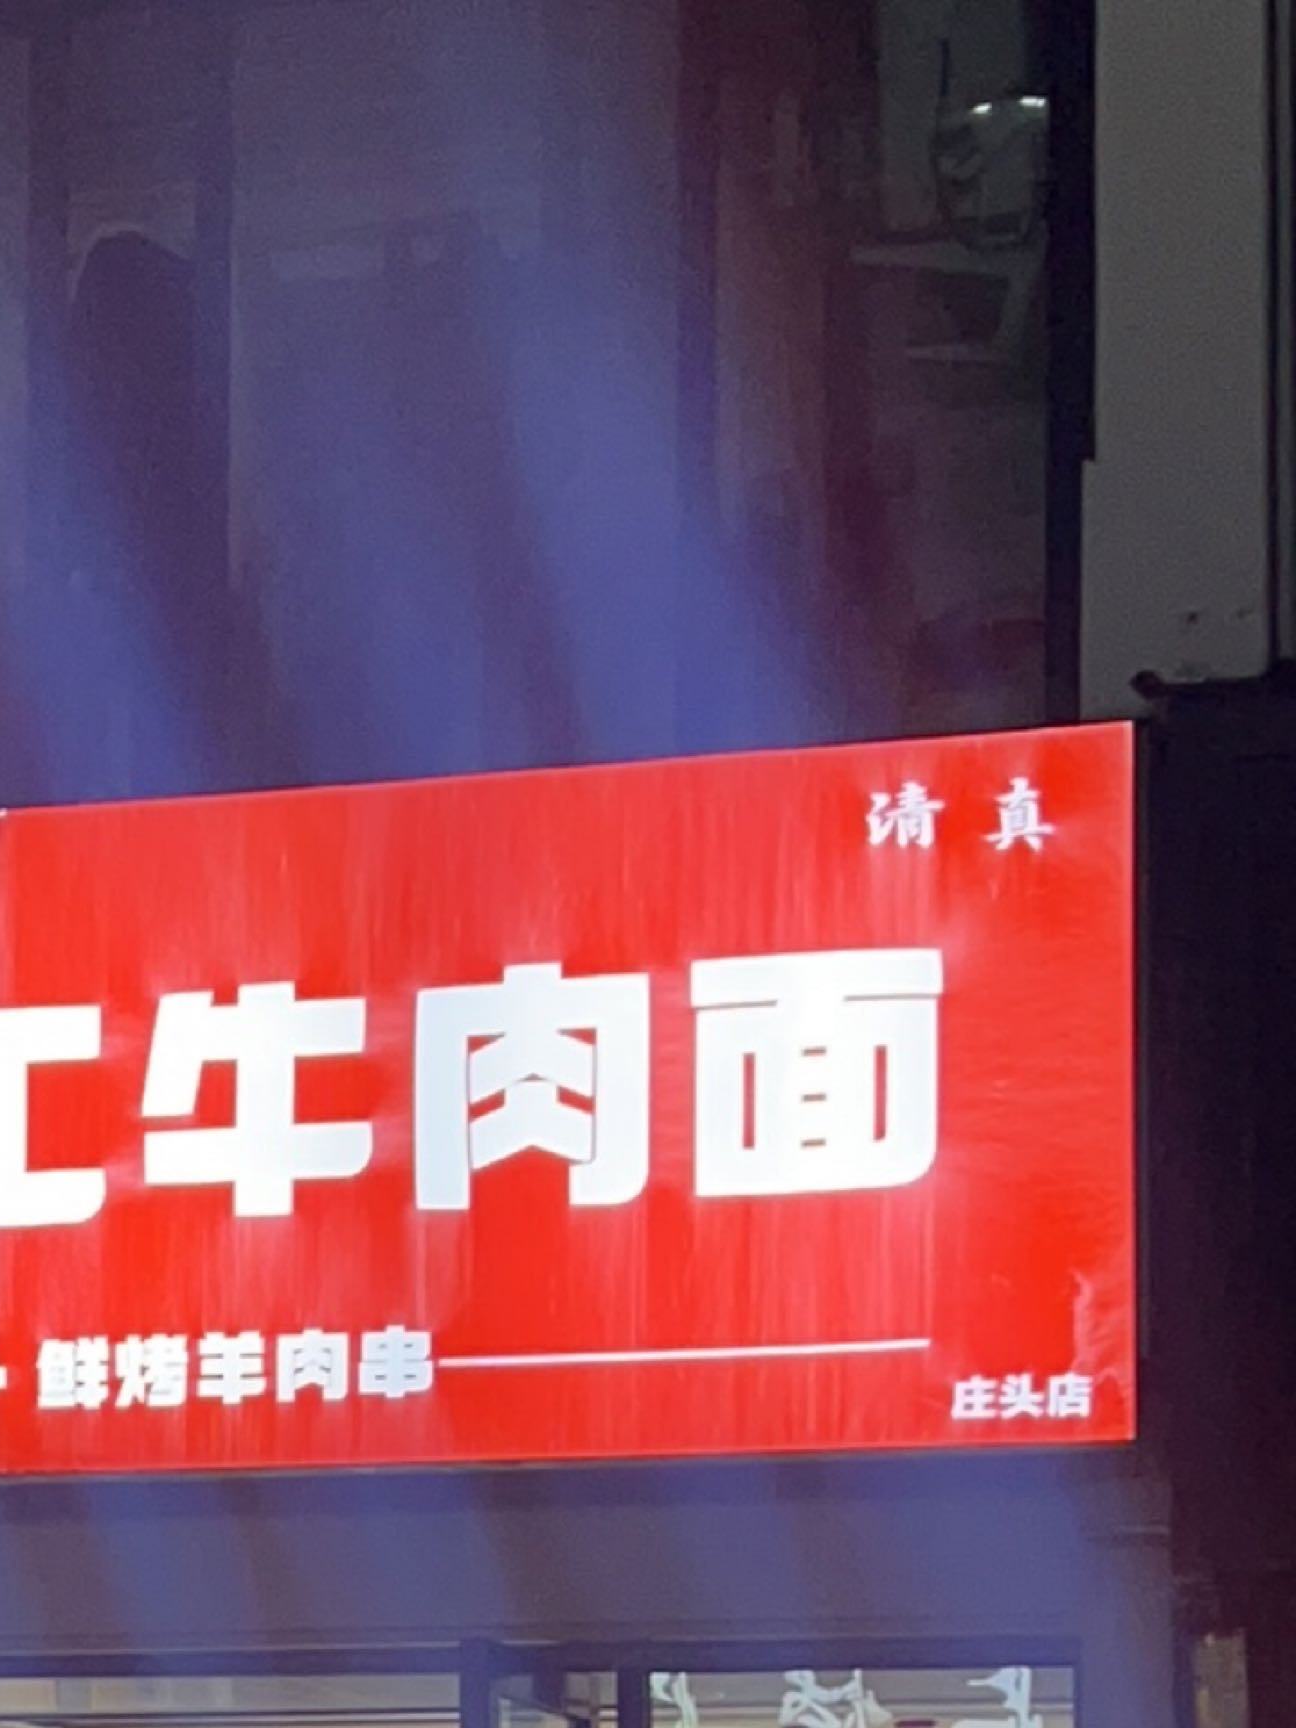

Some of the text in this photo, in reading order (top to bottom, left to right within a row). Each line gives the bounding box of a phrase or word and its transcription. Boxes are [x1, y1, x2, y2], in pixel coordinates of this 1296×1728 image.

[865, 776, 1054, 852] 清真
[949, 1373, 1093, 1424] 庄头店
